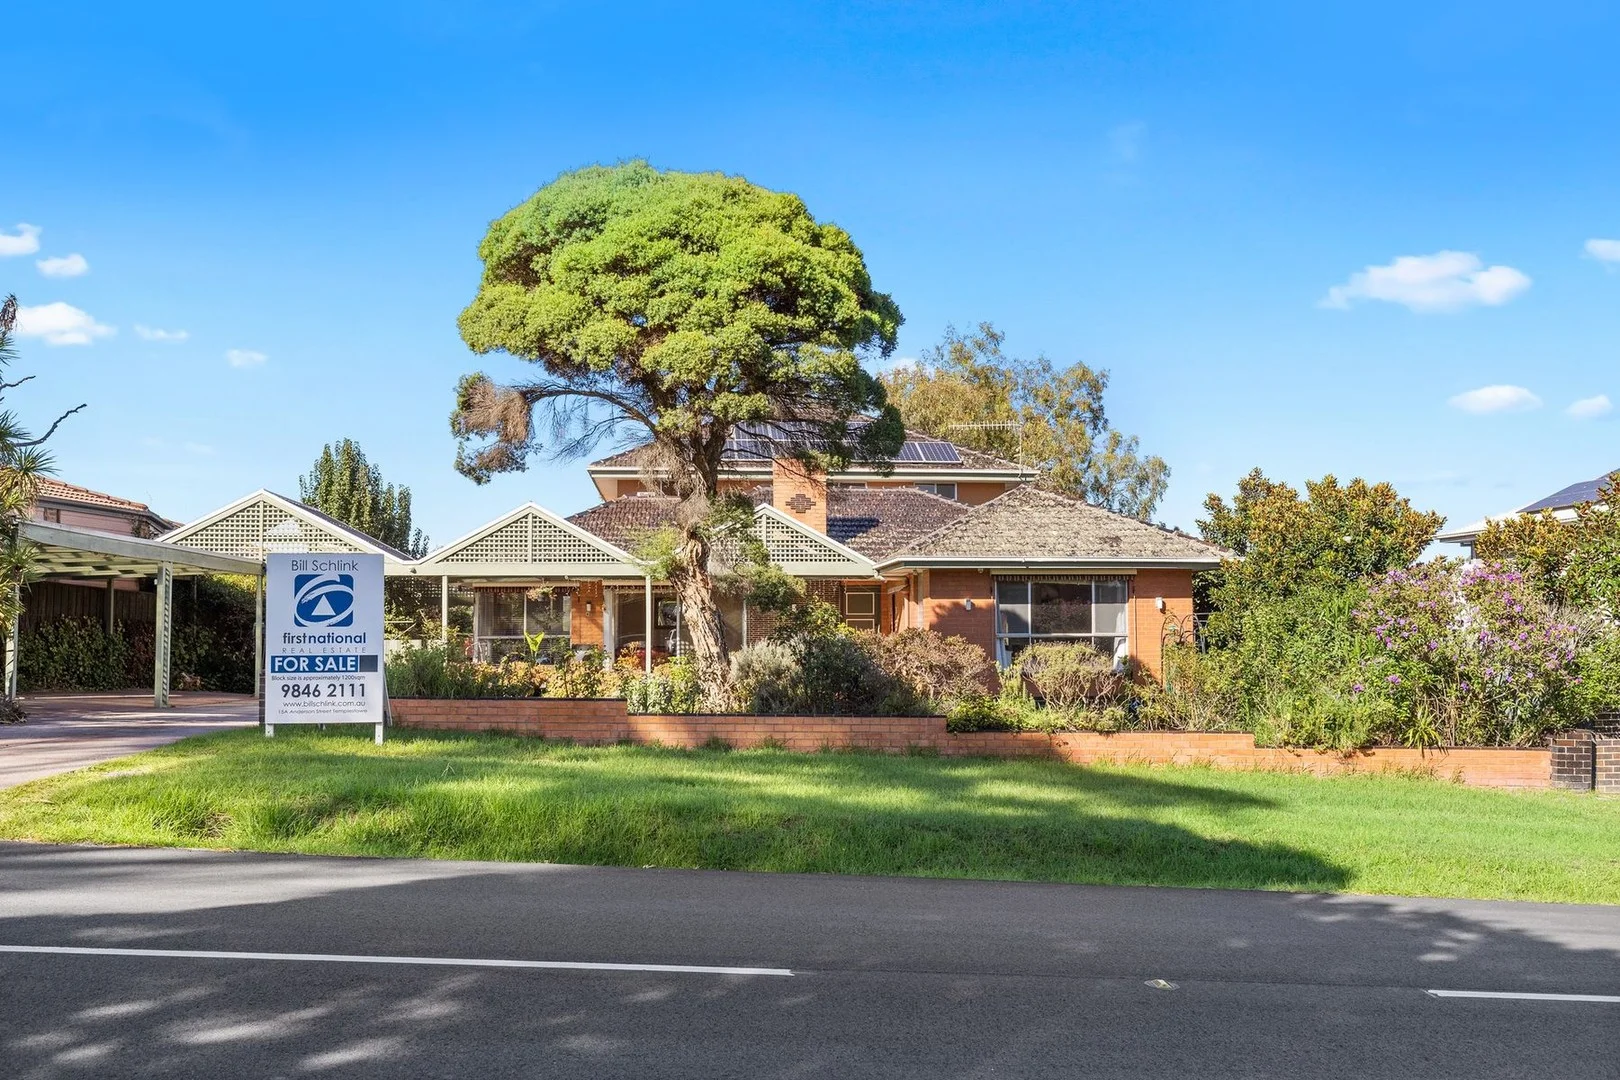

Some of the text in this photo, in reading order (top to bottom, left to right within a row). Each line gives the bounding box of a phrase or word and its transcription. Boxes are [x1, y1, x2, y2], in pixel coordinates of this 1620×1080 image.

[291, 559, 359, 572] Bill Schlink
[274, 657, 356, 672] FOR SALE
[281, 683, 366, 698] 9846 2111
